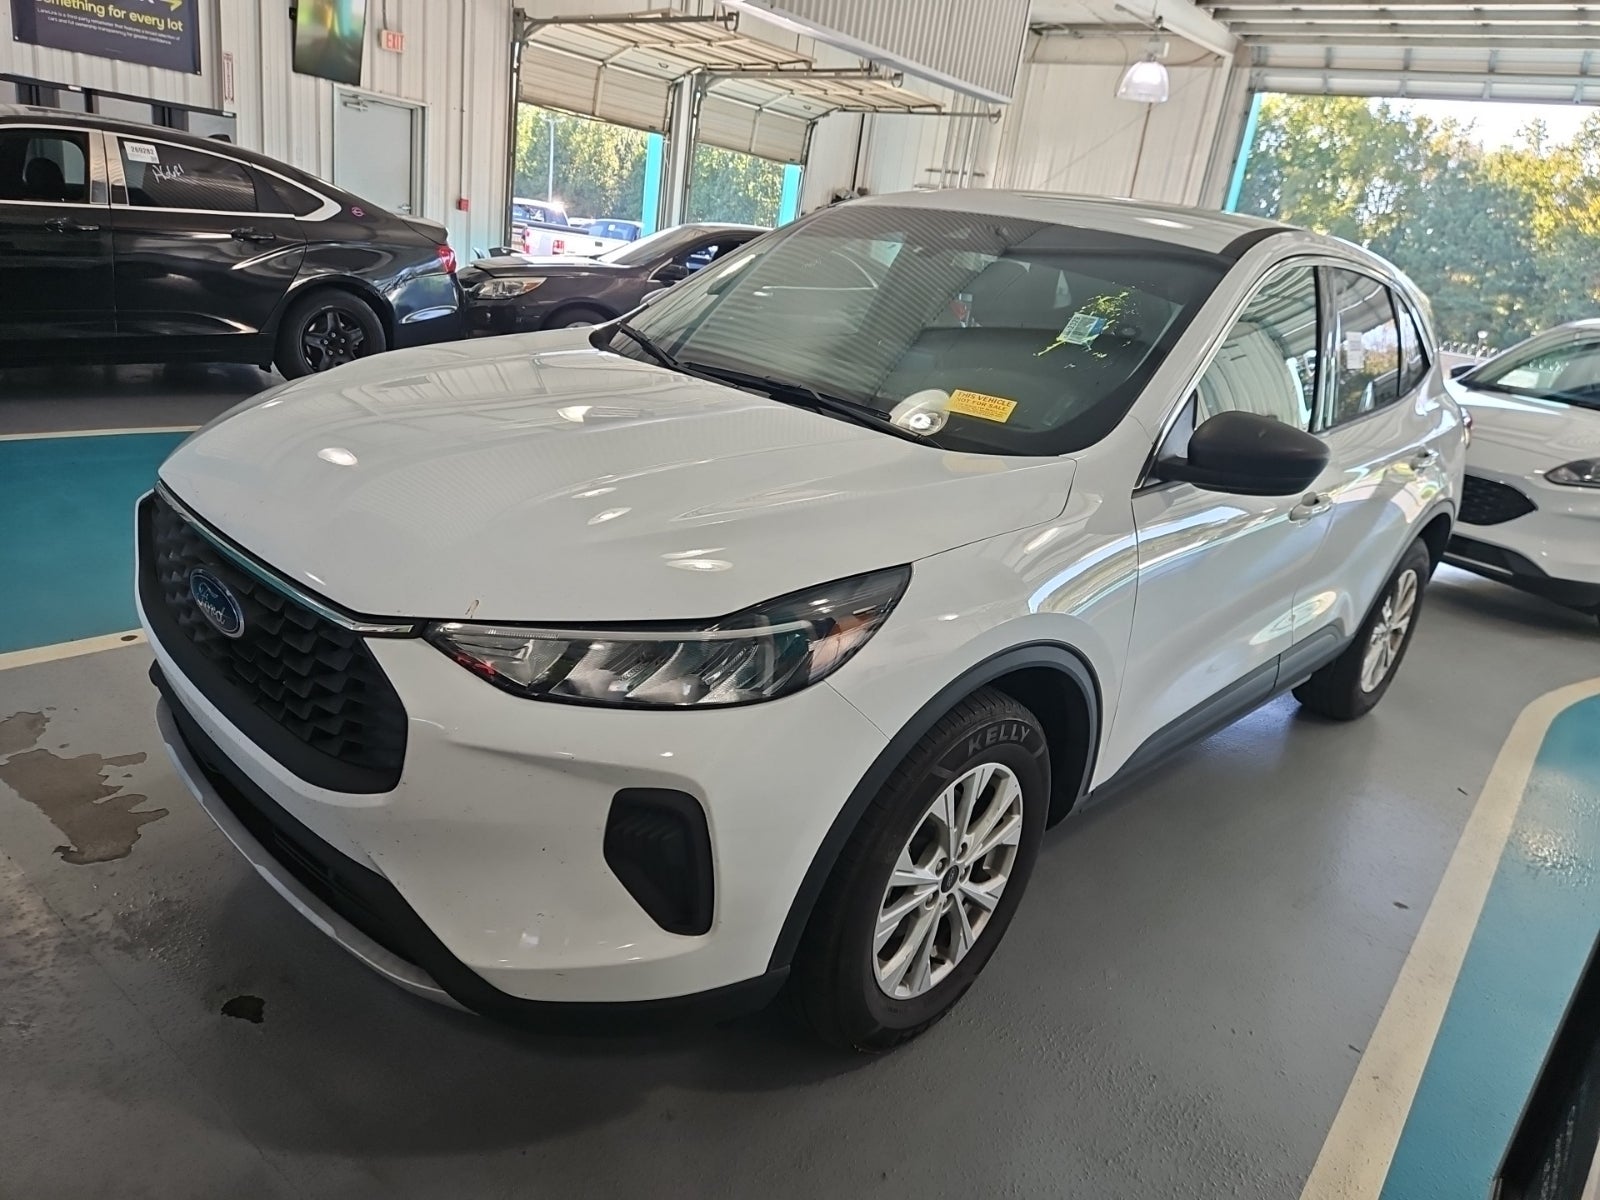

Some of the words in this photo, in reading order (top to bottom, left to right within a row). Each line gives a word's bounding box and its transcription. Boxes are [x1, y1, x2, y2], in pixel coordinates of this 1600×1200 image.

[36, 0, 105, 17] mething
[108, 4, 126, 19] for
[129, 12, 165, 30] every
[167, 18, 183, 32] lot
[386, 32, 404, 51] EXIT
[957, 391, 977, 400] THIS
[978, 395, 1013, 407] VEHICLE
[989, 403, 1007, 411] SALE
[195, 582, 228, 625] Ford
[967, 723, 1030, 757] KELLY
